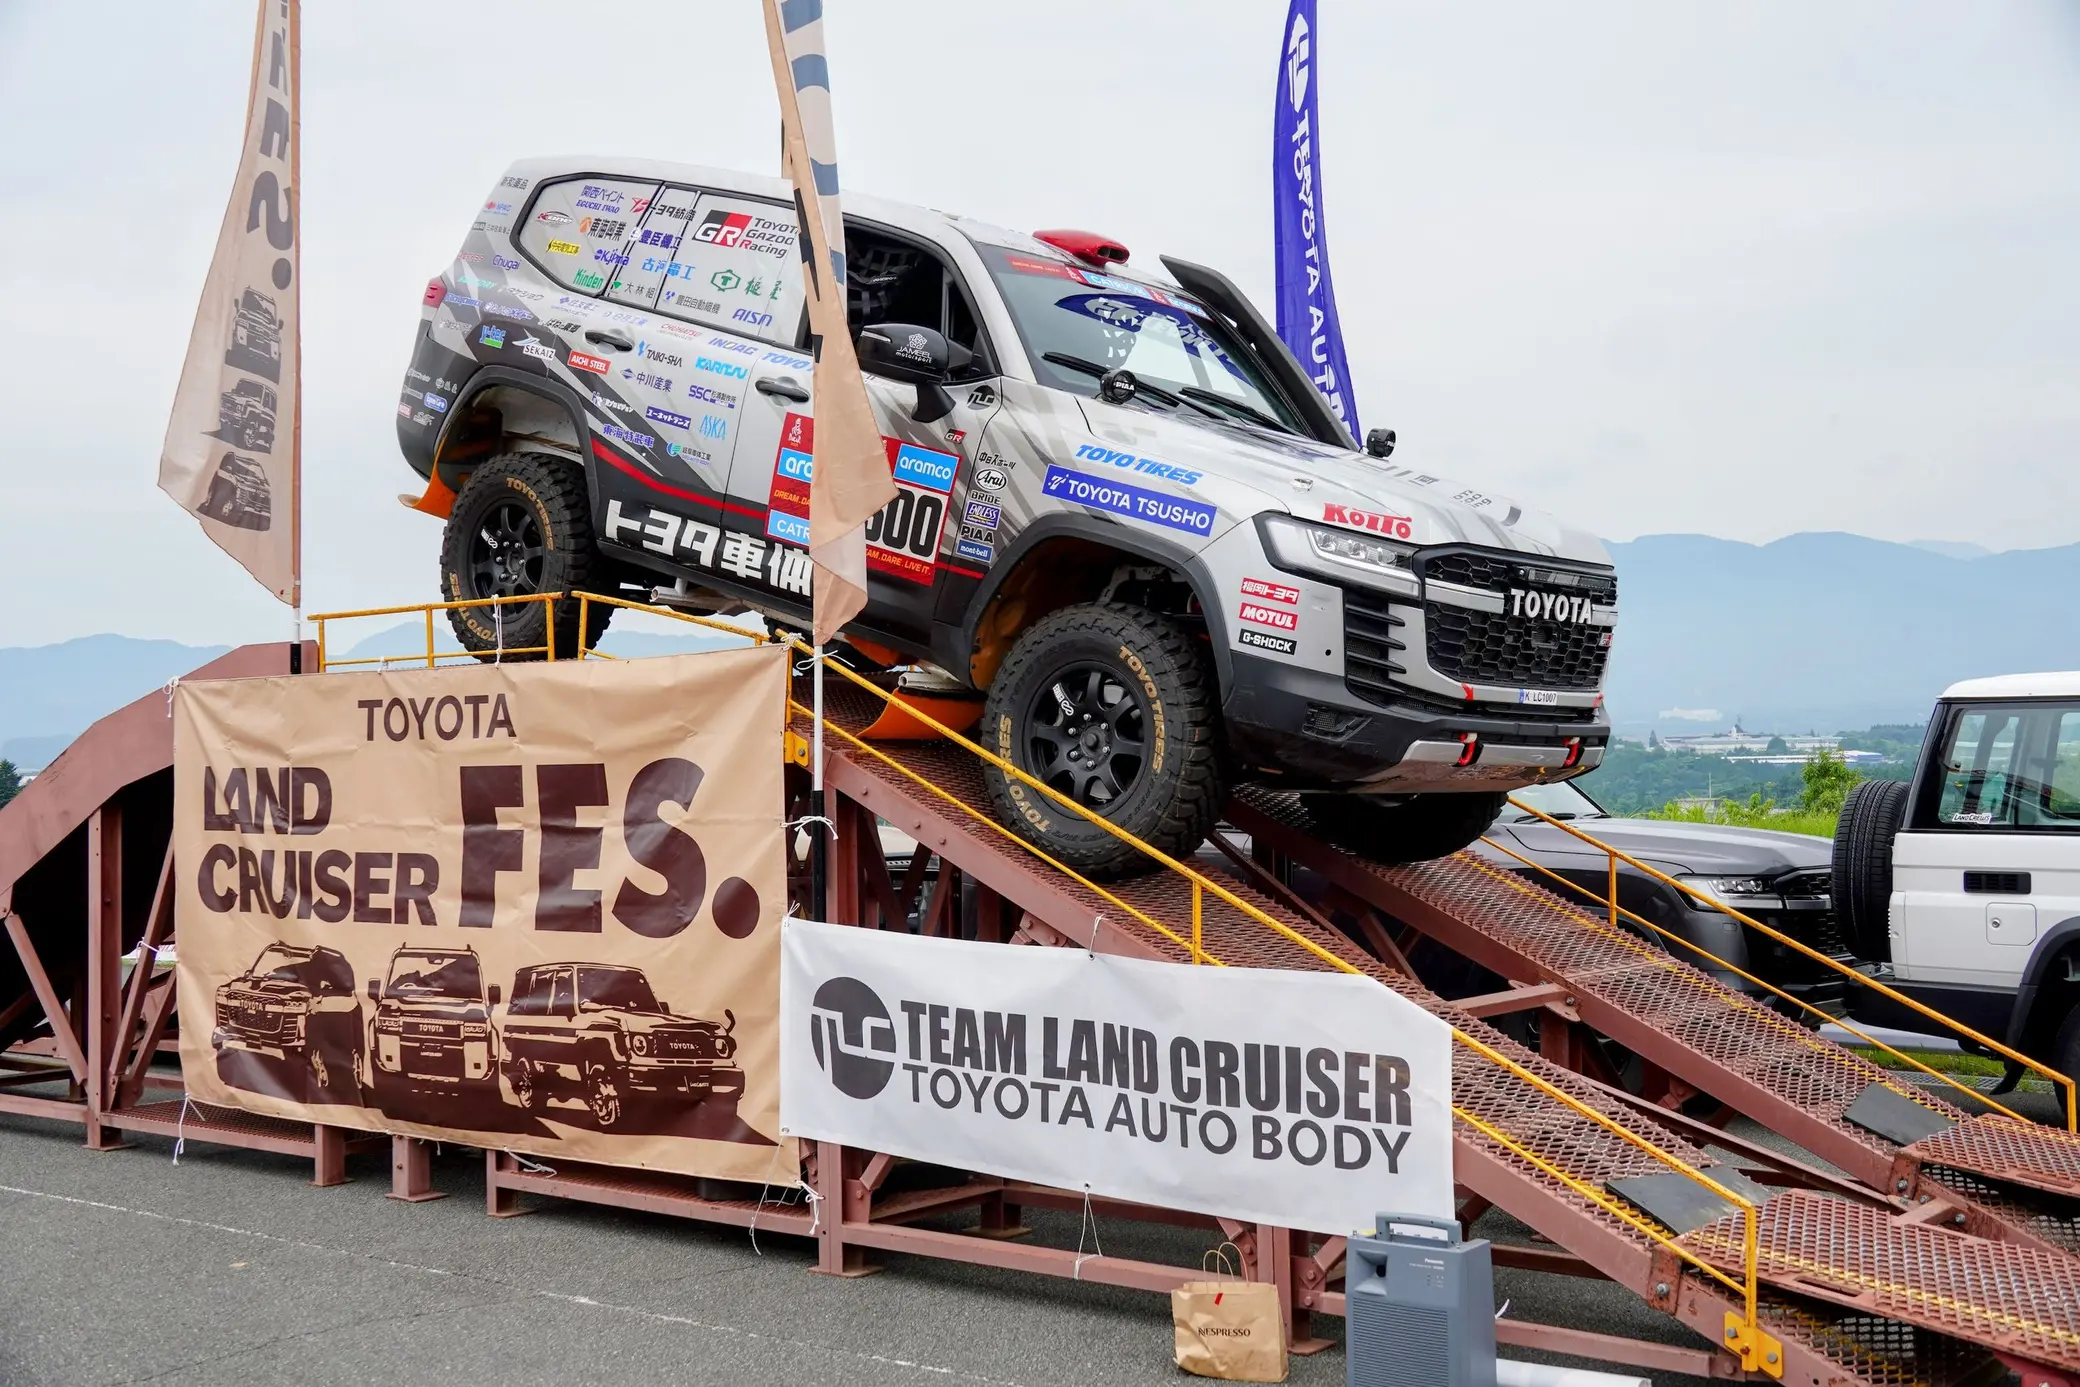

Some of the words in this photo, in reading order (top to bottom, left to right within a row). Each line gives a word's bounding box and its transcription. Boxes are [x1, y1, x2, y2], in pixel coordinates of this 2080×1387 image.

[694, 222, 742, 246] GR
[746, 229, 795, 245] GAZOO
[754, 218, 799, 235] TOYOT
[739, 240, 787, 258] Racing
[492, 255, 521, 270] Chugai
[573, 269, 604, 289] Kinden
[625, 283, 655, 298] 大林組
[571, 355, 588, 366] AICHI
[589, 360, 606, 371] STEEL
[897, 346, 932, 359] JAMEEL
[636, 372, 673, 393] 中川産業
[688, 385, 711, 401] SSC
[1116, 382, 1135, 391] PIAA
[603, 423, 654, 448] 東海特装車
[700, 415, 727, 441] ASKA
[945, 432, 964, 443] GR
[900, 455, 952, 480] aramco
[1075, 445, 1134, 468] TOYO
[1134, 456, 1203, 485] TIRES
[978, 471, 1003, 487] Arai
[971, 490, 1001, 504] BRIDE
[1068, 480, 1131, 510] TOYOTA
[1136, 498, 1211, 530] TSUSHO
[777, 519, 811, 540] CATR
[961, 525, 994, 543] PIAA
[605, 499, 813, 597] トヨタ車体
[1242, 605, 1295, 628] MOTUL
[1510, 588, 1593, 624] TOYOTA
[1242, 632, 1293, 652] G-SHOCK
[357, 693, 517, 741] TOYOTA
[1118, 645, 1157, 698] TOYO
[1151, 699, 1165, 774] TIRES
[204, 766, 332, 836] LAND
[458, 758, 760, 939] FES.
[199, 843, 440, 927] CRUISER
[419, 1024, 444, 1033] TOYOTA
[900, 1000, 1027, 1076] TEAM
[1041, 1015, 1158, 1094] LAND
[1169, 1038, 1412, 1127] CRUISER
[902, 1064, 1095, 1128] TOYOTA
[1106, 1093, 1238, 1156] AUTO
[1252, 1116, 1412, 1176] BODY
[1198, 1327, 1251, 1337] NESPRESSO
